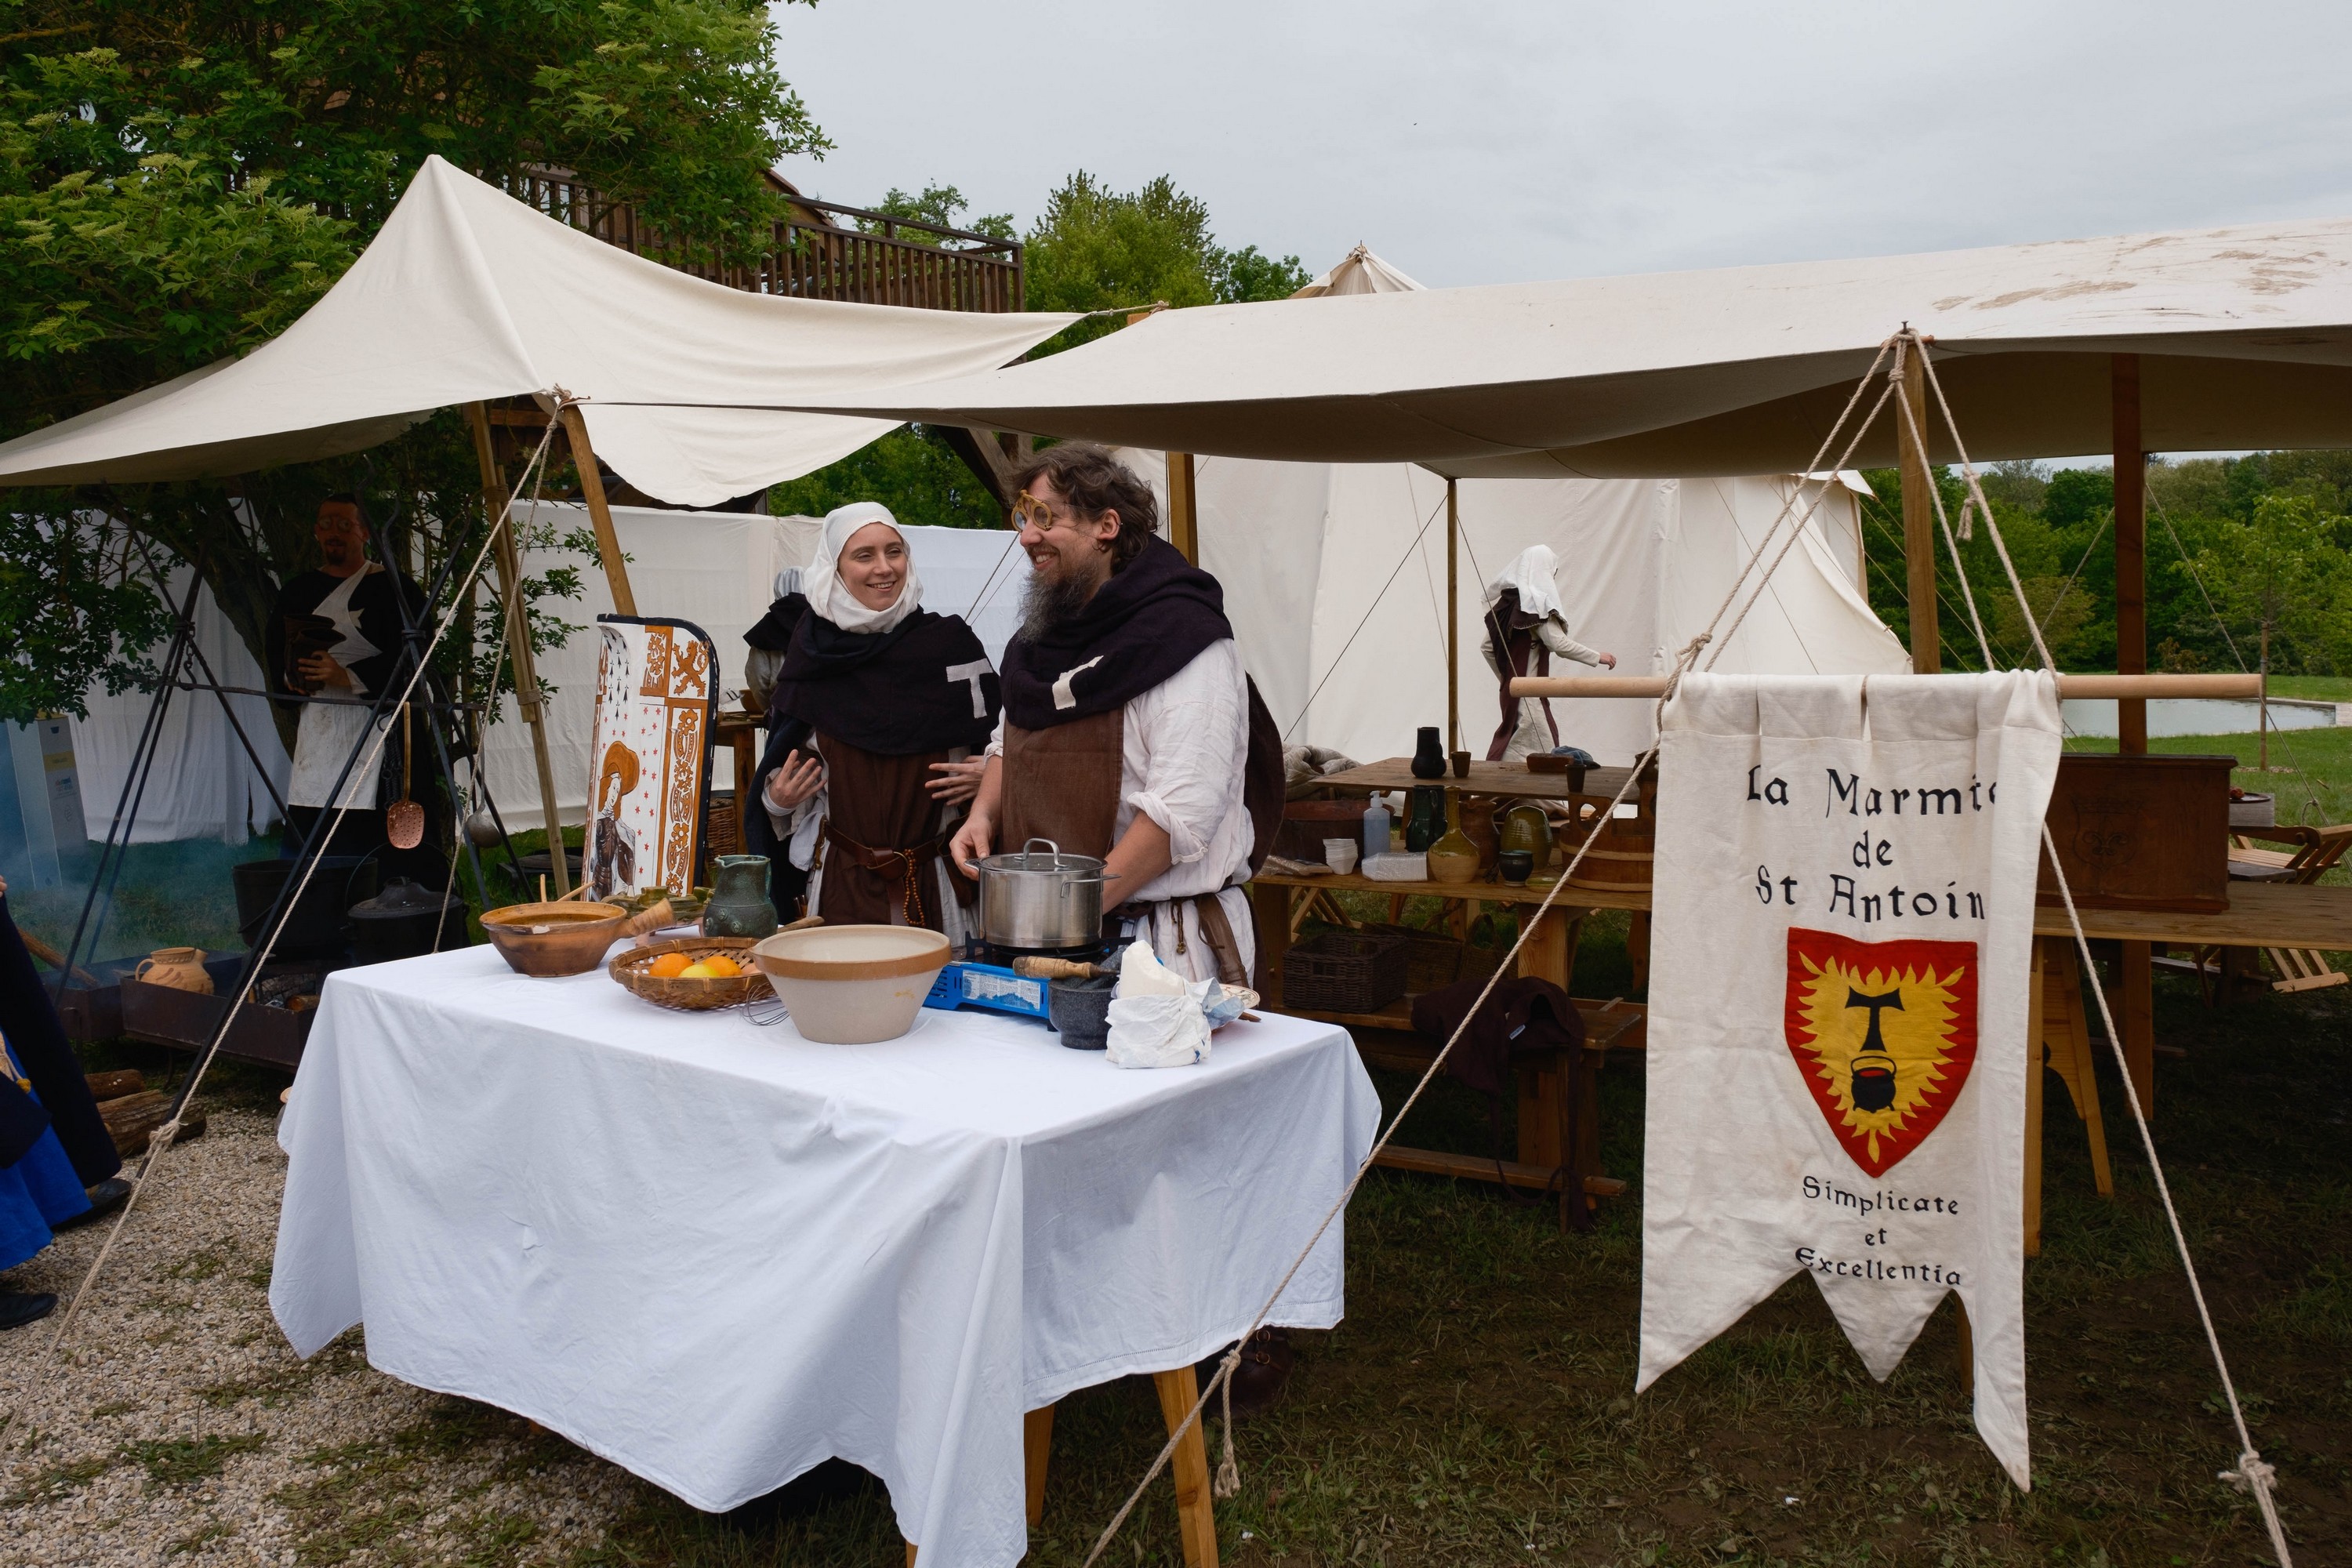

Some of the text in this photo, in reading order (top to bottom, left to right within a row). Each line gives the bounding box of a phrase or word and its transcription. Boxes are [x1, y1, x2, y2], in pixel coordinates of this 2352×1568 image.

[1747, 764, 1790, 806] La
[1853, 829, 1893, 869] de
[1755, 864, 1798, 906] St
[1802, 1175, 1959, 1217] Simplicate
[1864, 1228, 1888, 1247] et
[1795, 1247, 1962, 1287] Excellentia
